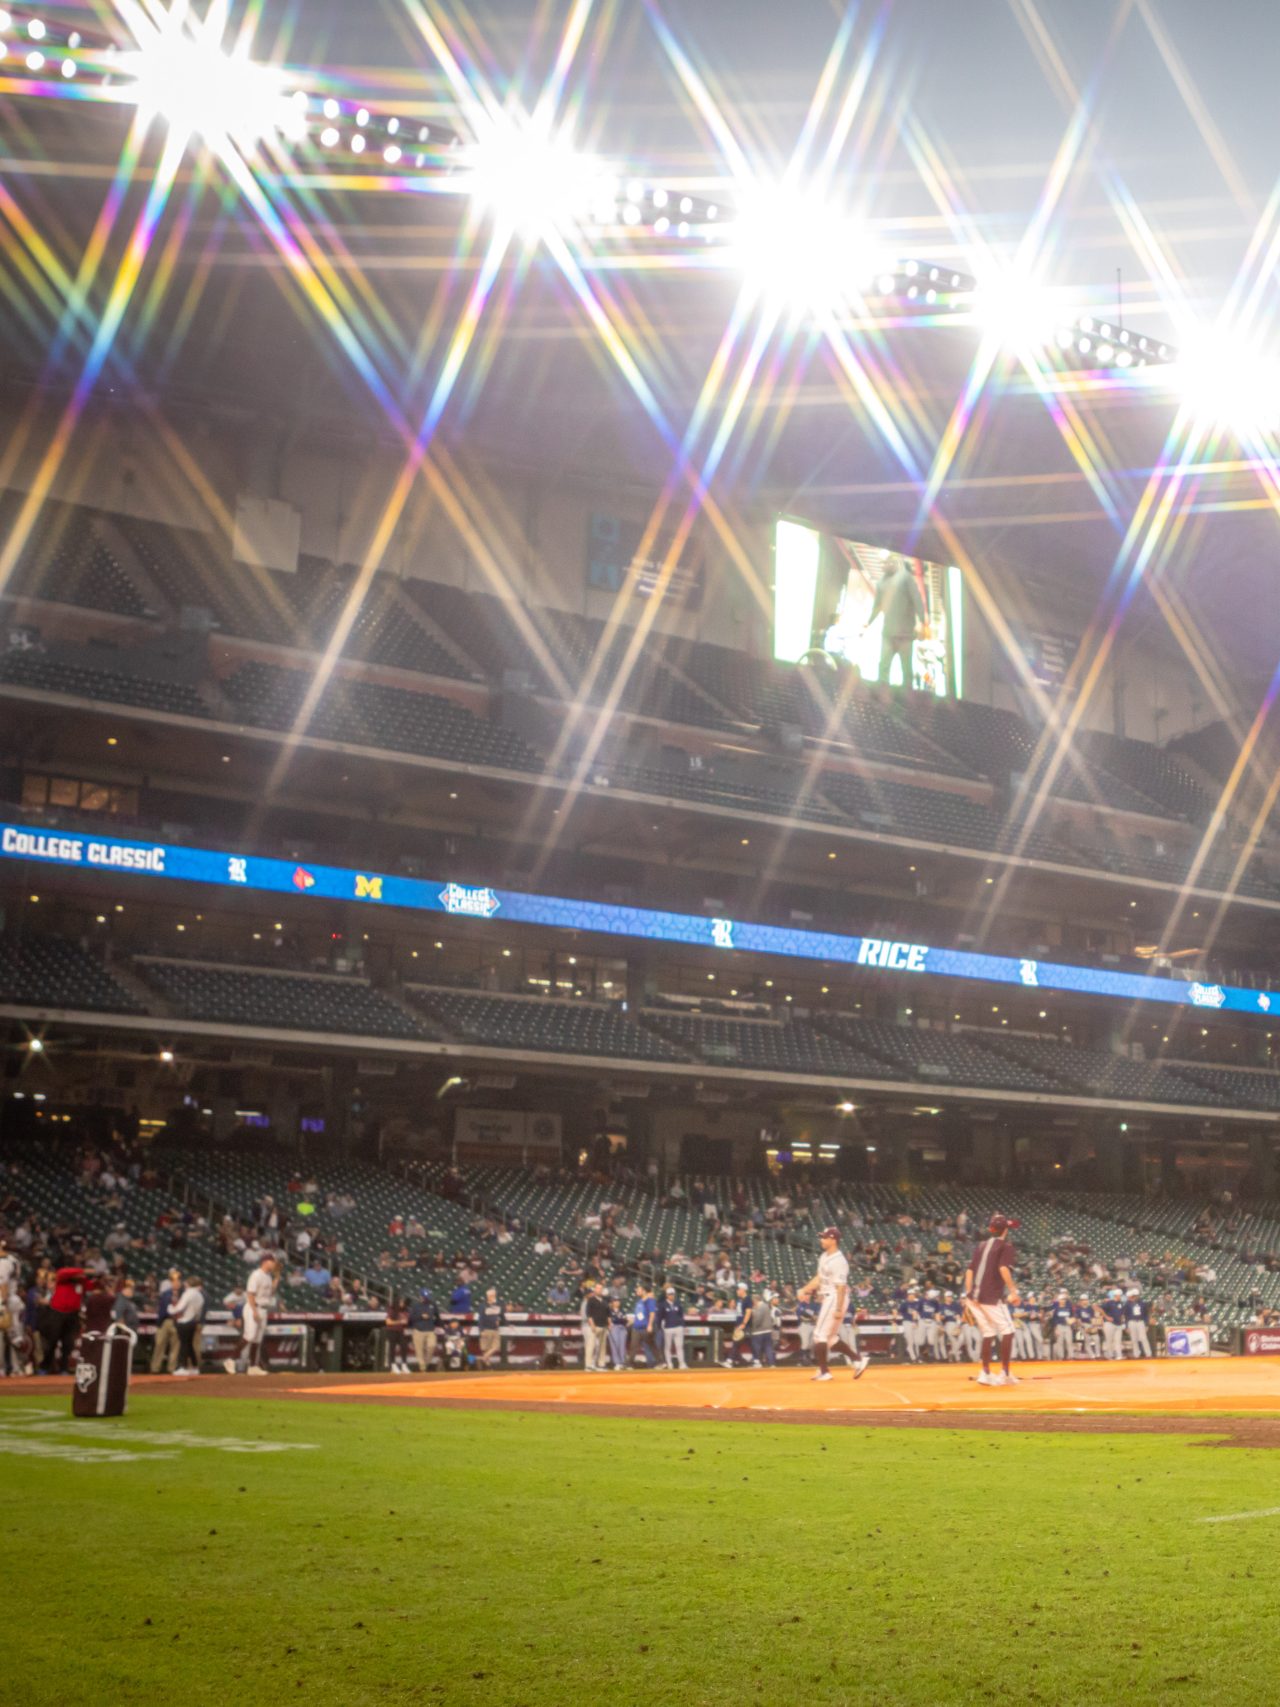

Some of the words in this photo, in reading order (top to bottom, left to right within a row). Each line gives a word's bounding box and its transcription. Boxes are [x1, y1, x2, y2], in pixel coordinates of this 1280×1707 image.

[2, 827, 83, 861] COLLEGE
[87, 842, 166, 872] CLASSIC
[354, 874, 383, 899] M
[857, 937, 929, 972] RICE
